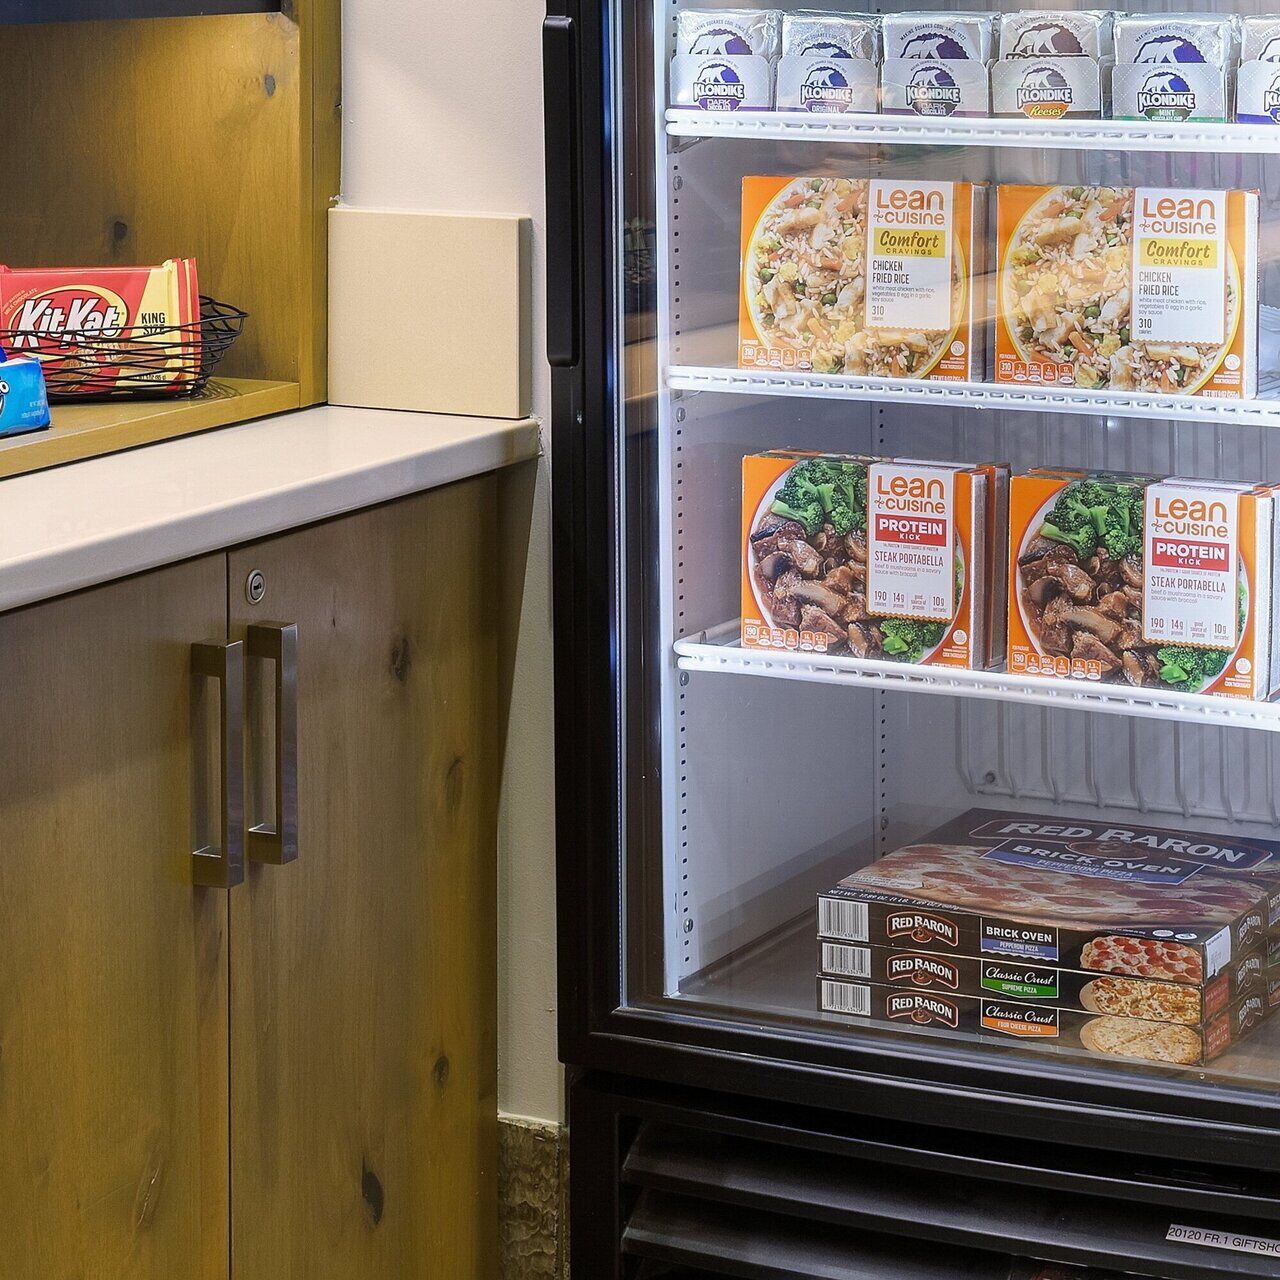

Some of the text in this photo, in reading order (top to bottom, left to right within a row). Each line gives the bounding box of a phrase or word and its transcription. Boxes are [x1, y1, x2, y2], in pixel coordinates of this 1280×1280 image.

[693, 82, 746, 102] KLONDIKE
[800, 85, 854, 105] KLONDIKE
[906, 84, 961, 105] KLONDIKE
[1017, 86, 1072, 109] KLONDIKE
[1137, 92, 1196, 110] KLONDIKE
[811, 105, 840, 114] ORIGINAL
[1030, 105, 1063, 118] Reese's
[877, 188, 944, 211] Lean
[1142, 197, 1216, 220] Lean
[879, 230, 940, 249] Comfort
[885, 247, 933, 256] CRAVINGS
[1146, 240, 1210, 259] Comfort
[872, 260, 903, 272] CHICKEN
[872, 273, 910, 285] FRIED RICE
[1139, 271, 1172, 283] CHICKEN
[1139, 284, 1179, 297] FRIED RICE
[141, 312, 166, 325] KING
[871, 306, 885, 316] 310
[1138, 318, 1153, 329] 310
[877, 474, 945, 500] Lean
[1154, 497, 1228, 524] Lean
[879, 517, 943, 536] PROTEIN
[899, 532, 921, 541] KICK
[874, 549, 944, 567] STEAK PORTABELLA
[1155, 542, 1226, 561] PROTEIN
[1178, 557, 1202, 566] KICK
[1150, 575, 1226, 594] STEAK PORTABELLA
[874, 590, 887, 602] 190
[893, 592, 905, 604] 14g
[932, 595, 945, 608] 10g
[1150, 617, 1164, 629] 190
[1171, 619, 1184, 631] 14g
[1214, 623, 1227, 635] 10g
[999, 822, 1247, 863] RED BARON
[1011, 844, 1182, 874] BRICK OVEN
[891, 915, 953, 938] RED BARON
[986, 926, 1052, 943] BRICK OVEN
[999, 941, 1039, 952] PEPPERONI PIZZA
[891, 957, 953, 981] RED BARON
[985, 966, 1054, 986] Classic Crust
[1001, 983, 1038, 994] SUPREME PIZZA
[891, 996, 953, 1020] RED BARON
[985, 1004, 1054, 1025] Classic Crust
[1026, 1023, 1042, 1033] PIZZA
[1168, 1227, 1202, 1241] 20120
[1203, 1232, 1228, 1245] FR.1
